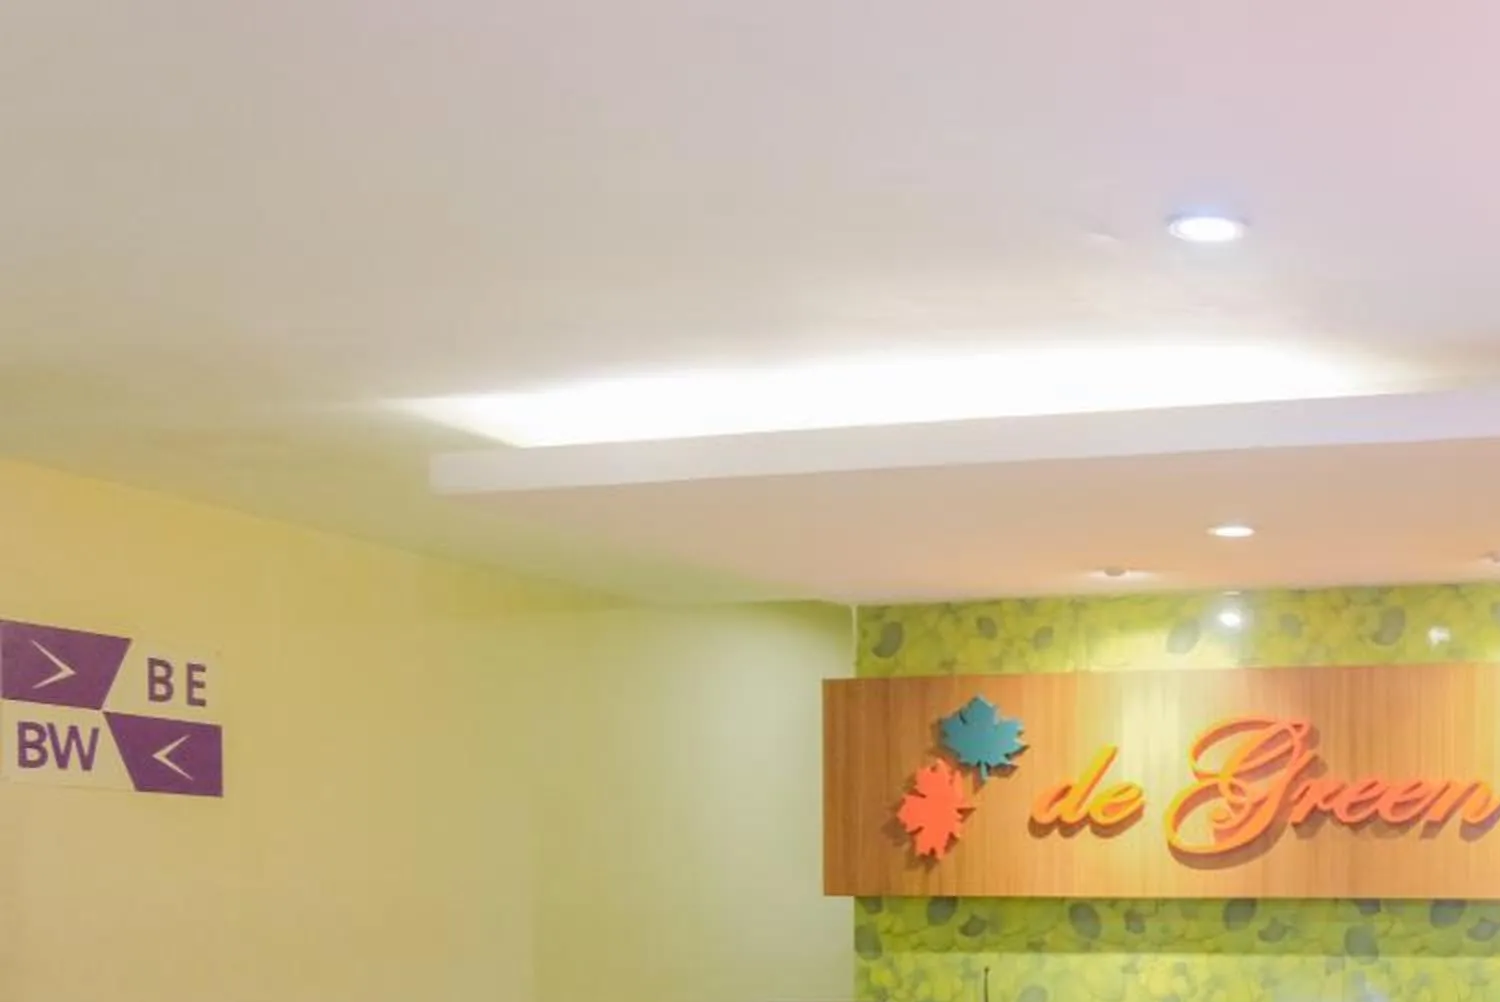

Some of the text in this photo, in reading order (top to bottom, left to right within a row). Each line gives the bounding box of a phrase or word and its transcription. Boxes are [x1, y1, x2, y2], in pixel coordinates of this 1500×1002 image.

[147, 656, 208, 708] BE
[17, 721, 100, 772] BW
[1031, 745, 1144, 828] de
